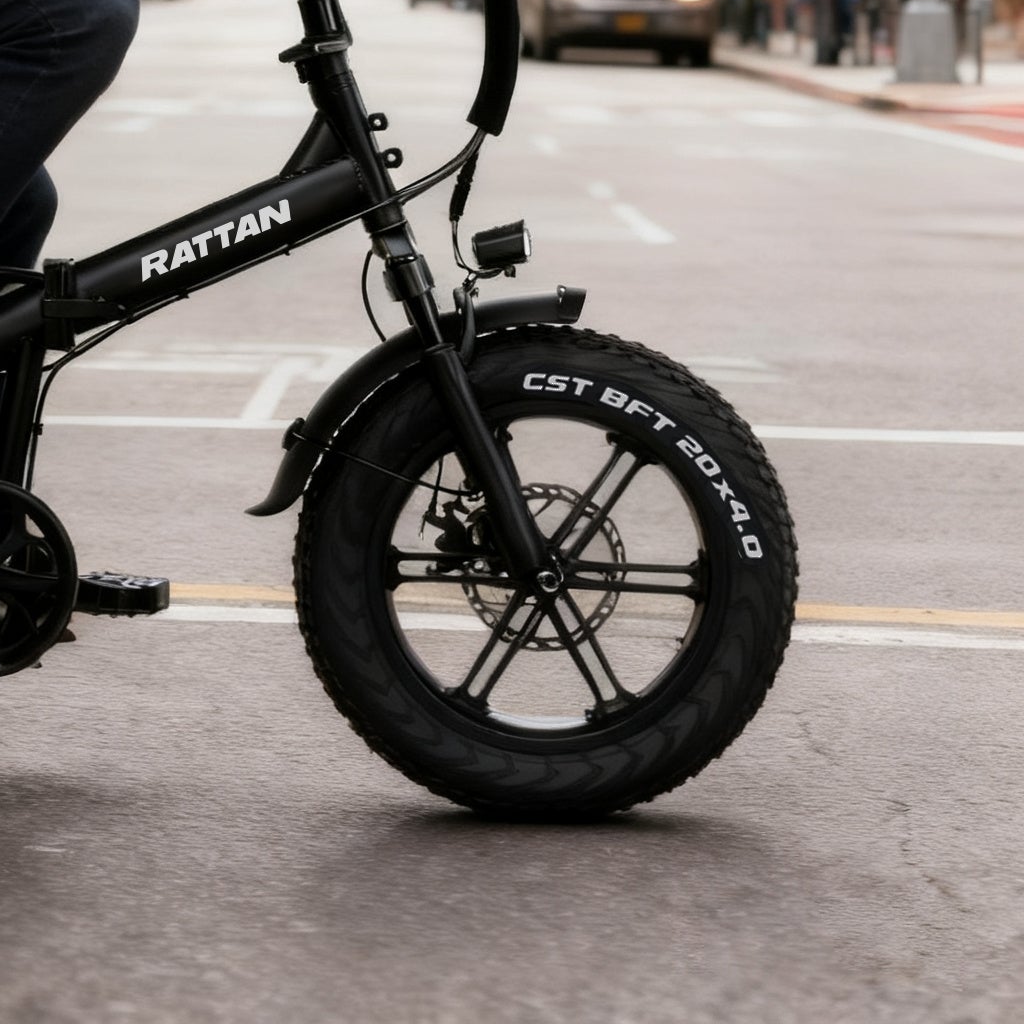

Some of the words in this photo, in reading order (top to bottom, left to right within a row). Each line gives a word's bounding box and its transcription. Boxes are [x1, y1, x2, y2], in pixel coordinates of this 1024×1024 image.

[141, 198, 292, 283] RATTAN
[522, 373, 594, 396] CST
[599, 387, 676, 431] BFT
